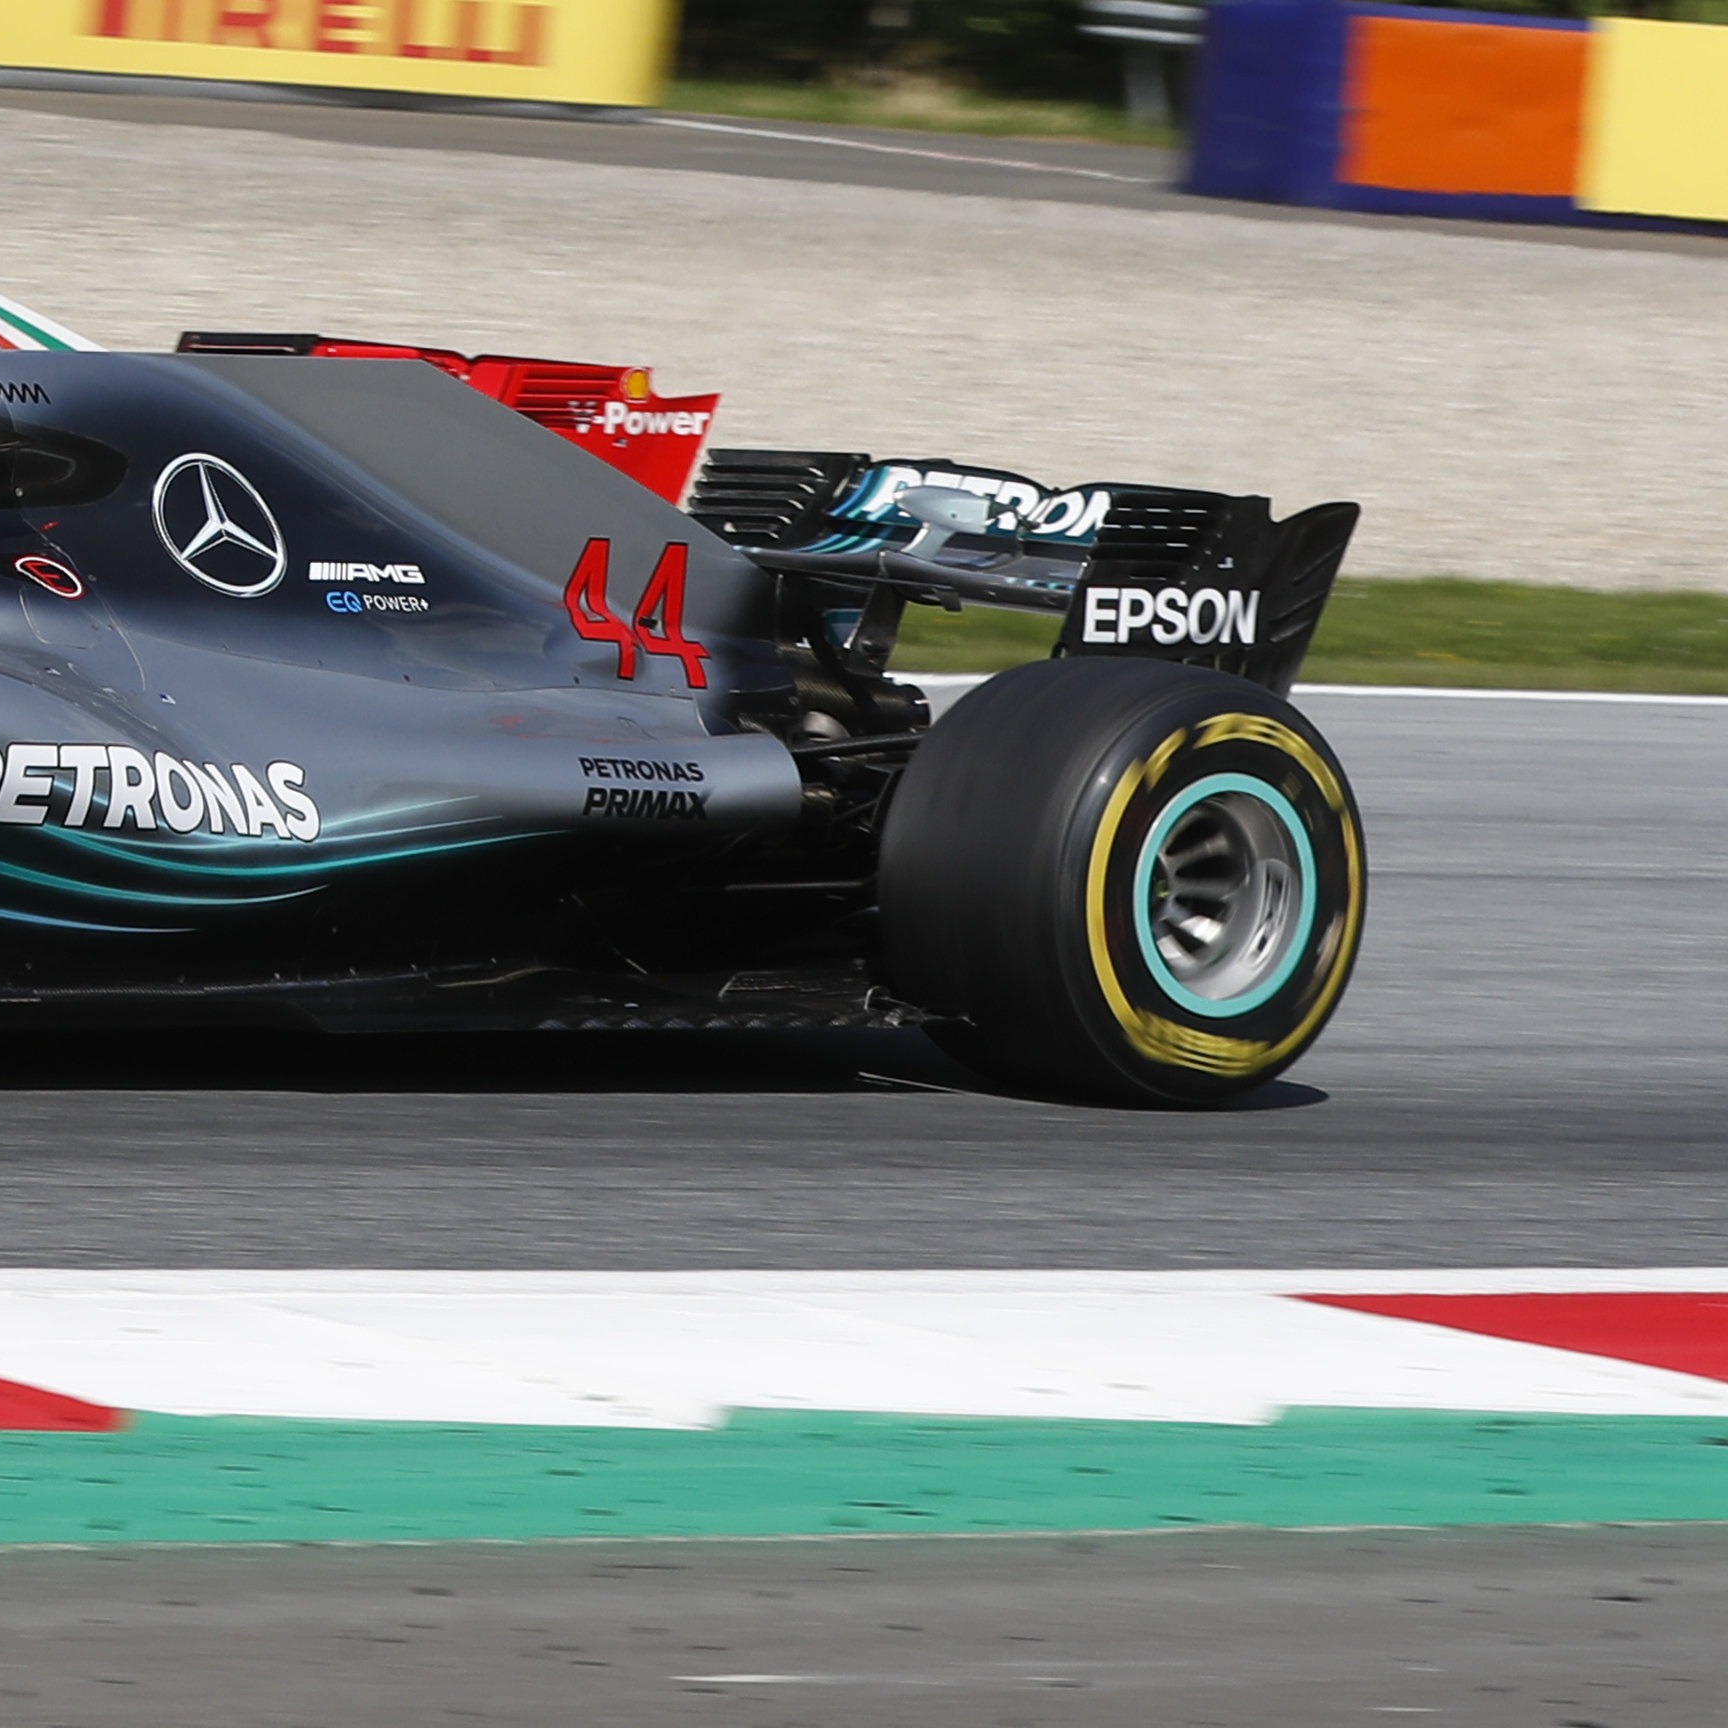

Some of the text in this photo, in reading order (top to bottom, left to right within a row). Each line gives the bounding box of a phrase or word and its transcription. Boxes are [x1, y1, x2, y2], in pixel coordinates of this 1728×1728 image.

[567, 401, 710, 437] V-Power
[344, 563, 425, 584] AMG
[564, 537, 712, 689] 44
[1082, 587, 1260, 645] EPSON
[578, 756, 705, 782] PETRONAS
[582, 787, 714, 821] PRIMAX
